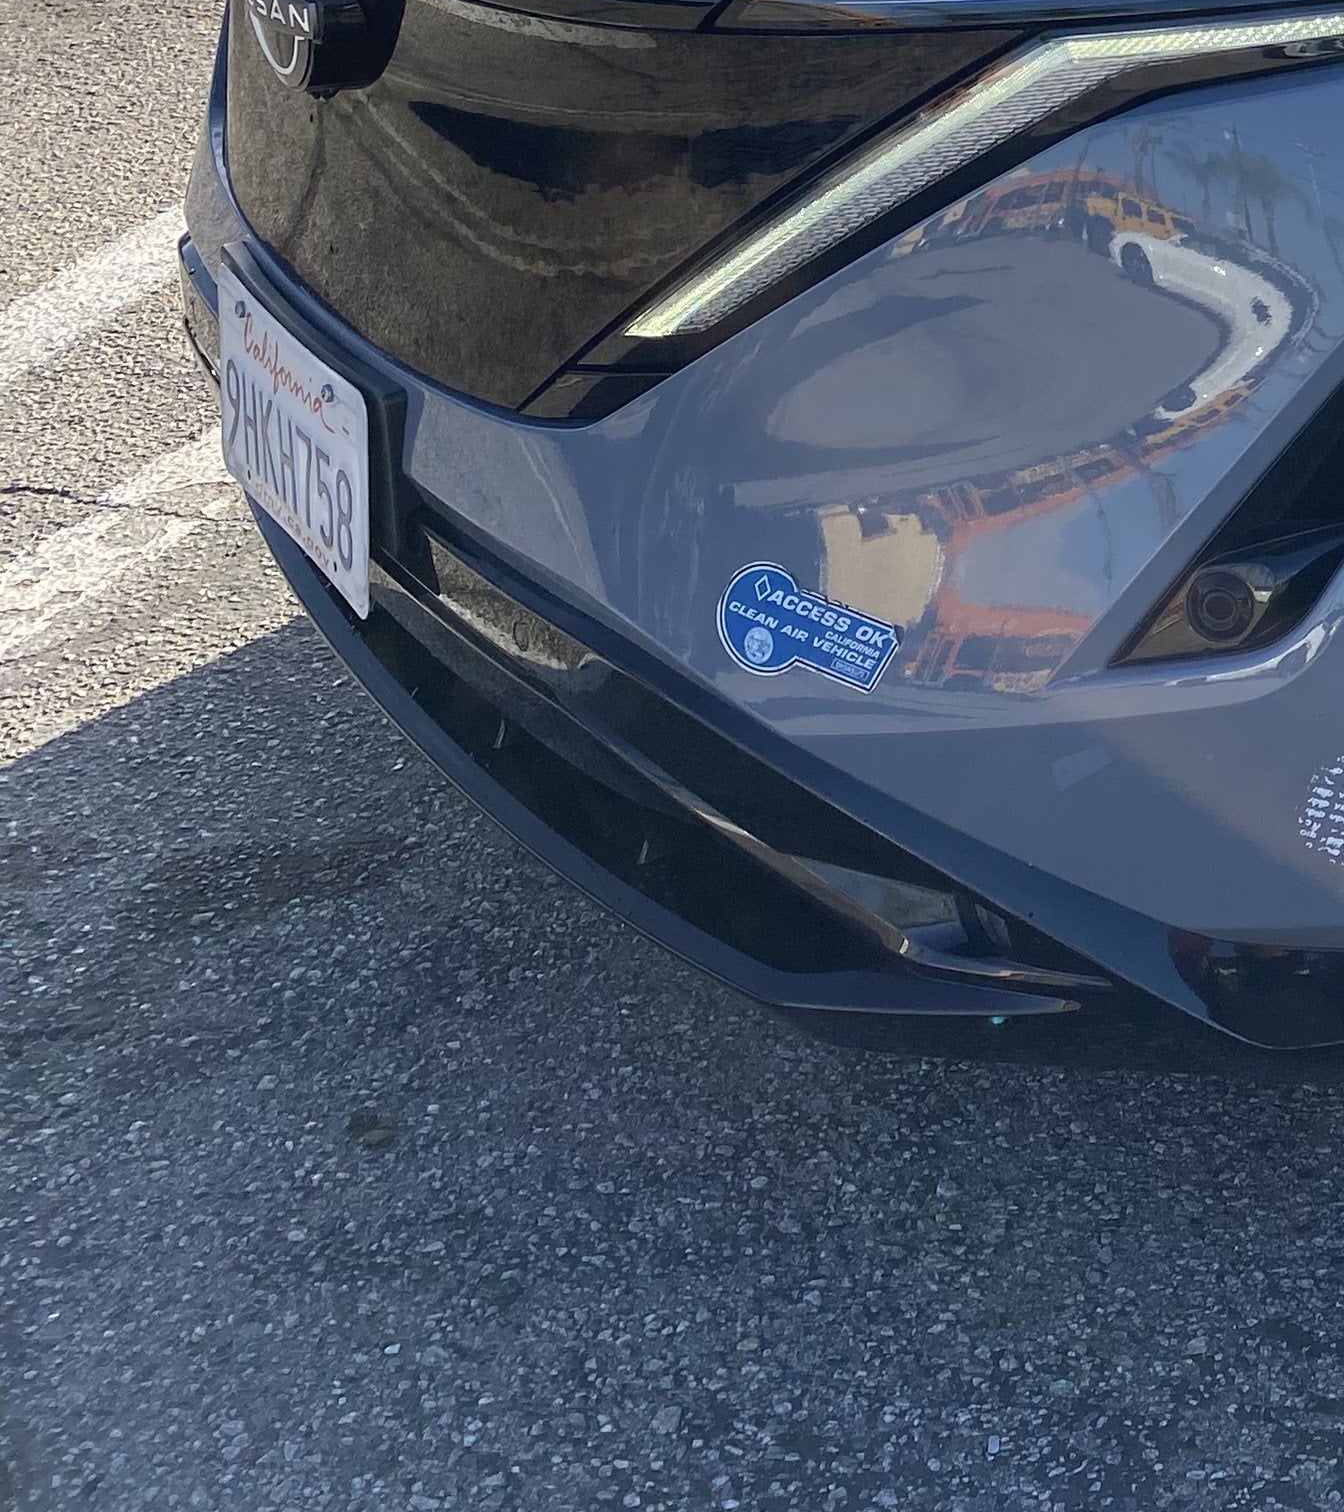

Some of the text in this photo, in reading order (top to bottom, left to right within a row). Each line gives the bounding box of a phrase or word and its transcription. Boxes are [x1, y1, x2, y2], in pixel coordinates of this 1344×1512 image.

[243, 313, 336, 434] California
[226, 358, 353, 573] 9HKH758
[729, 601, 779, 630] CLEAN
[780, 625, 809, 642] AIR
[812, 636, 877, 670] VEHICLE
[766, 590, 891, 648] ACCESS OK
[825, 631, 880, 660] CALIFORNIA
